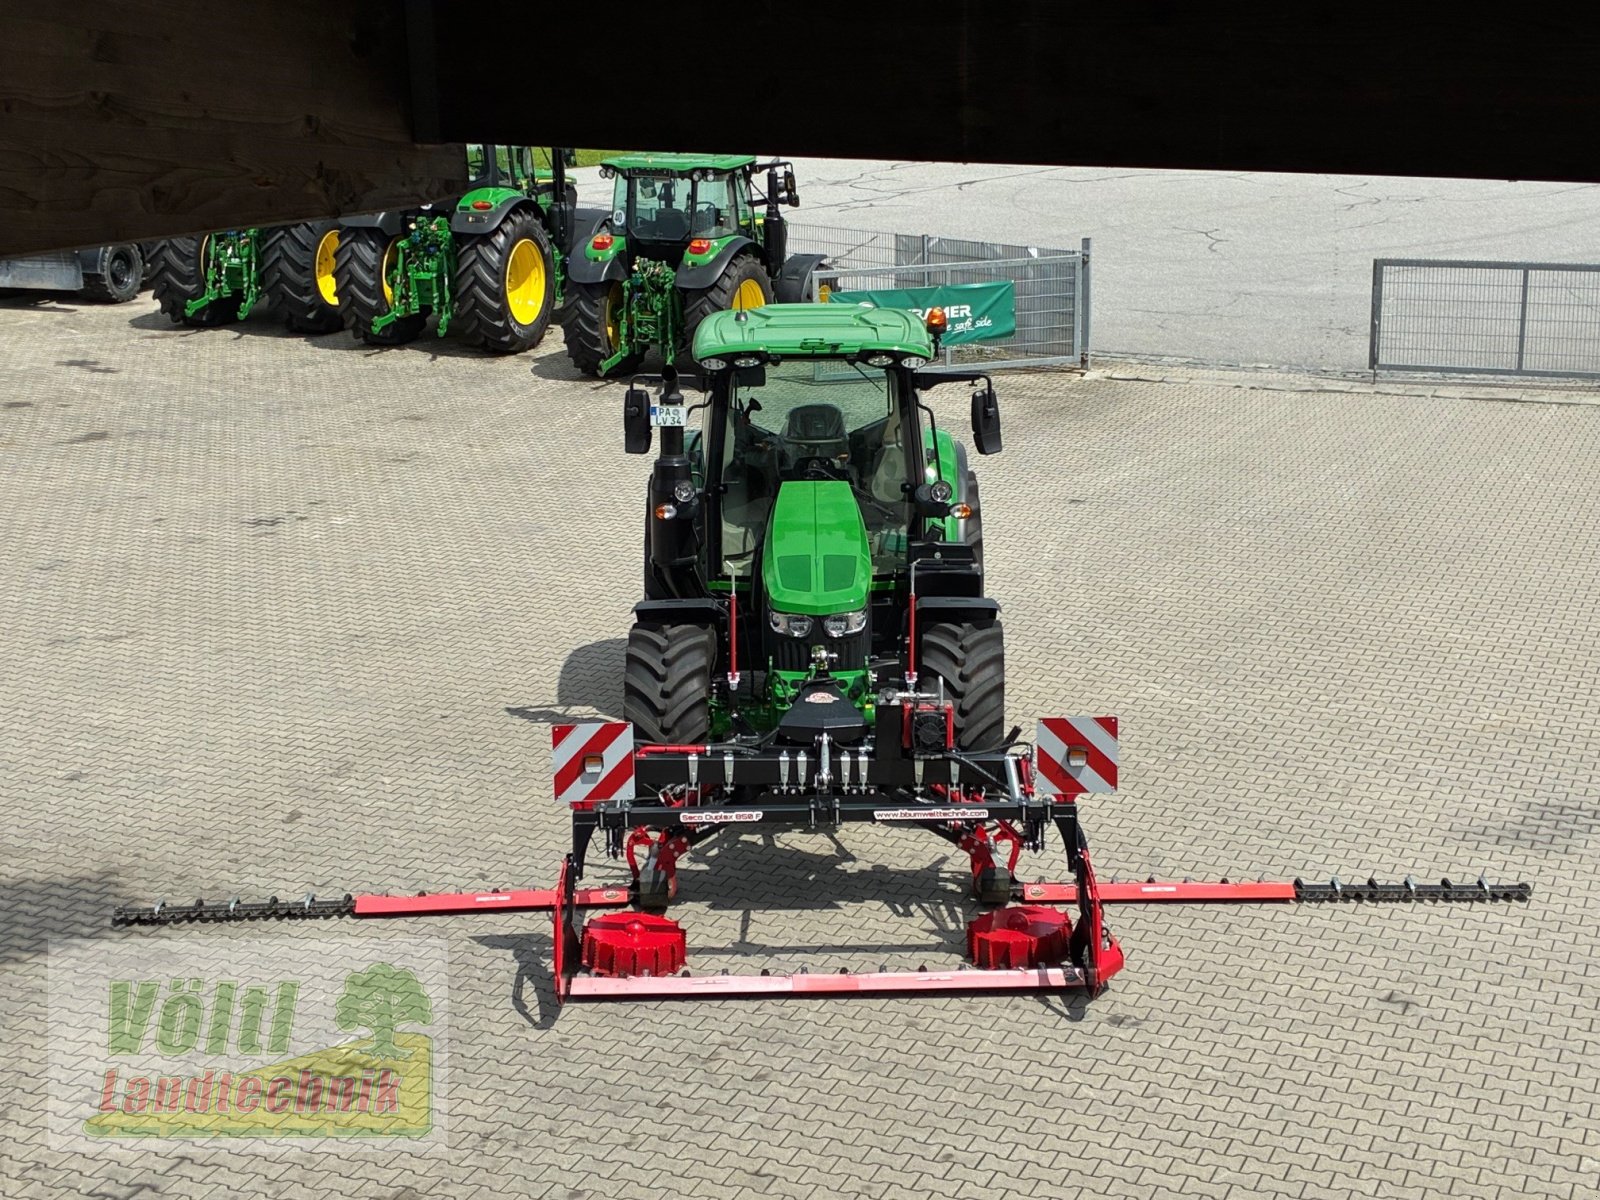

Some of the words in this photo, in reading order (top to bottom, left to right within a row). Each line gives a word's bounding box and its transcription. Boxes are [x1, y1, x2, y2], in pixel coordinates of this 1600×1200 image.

[615, 211, 623, 223] 40
[954, 318, 973, 333] safe
[974, 315, 993, 328] side
[658, 407, 671, 417] PA
[655, 415, 668, 425] LV
[670, 416, 682, 425] 34
[704, 813, 733, 823] Duplex
